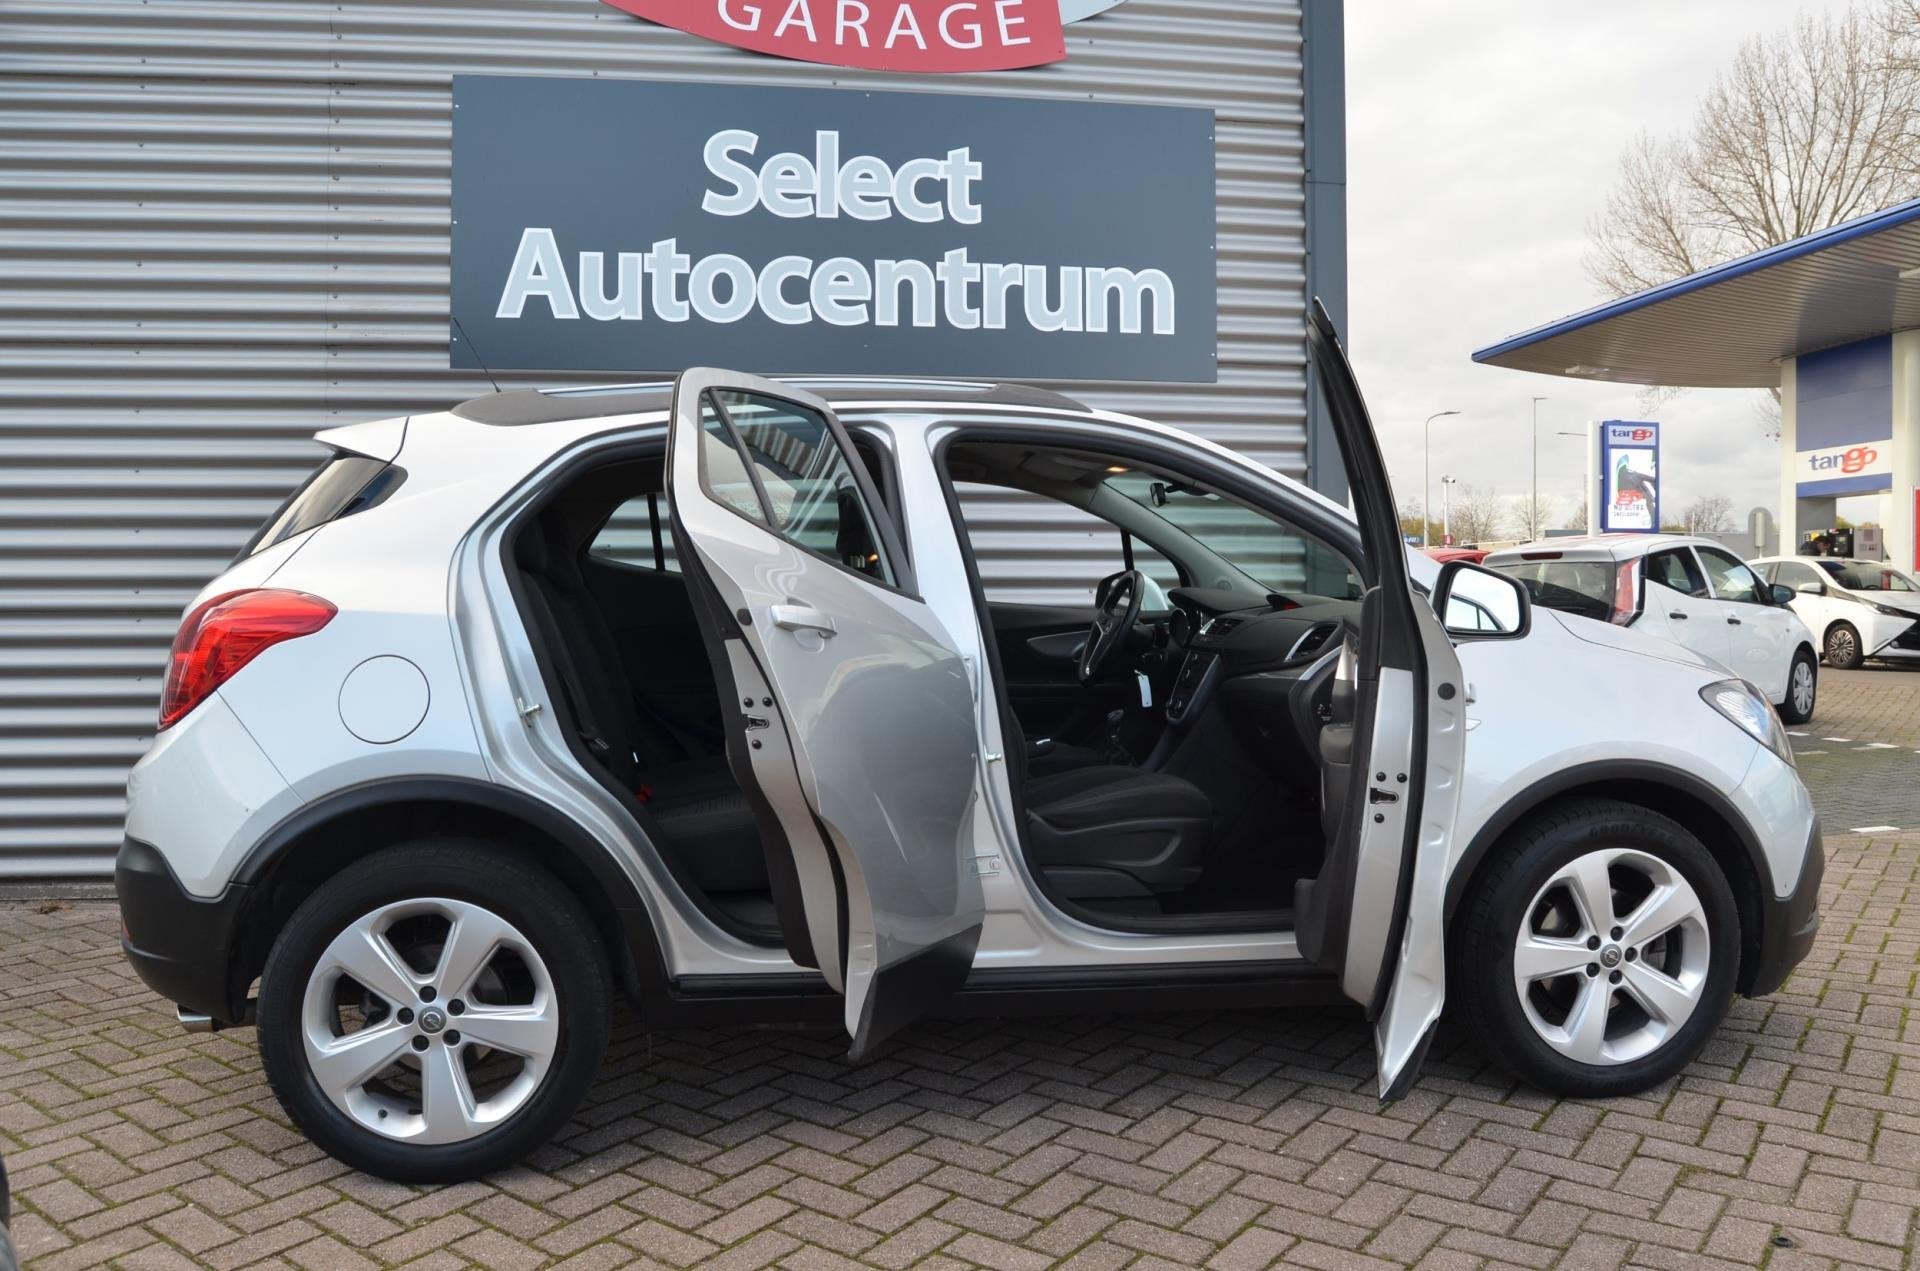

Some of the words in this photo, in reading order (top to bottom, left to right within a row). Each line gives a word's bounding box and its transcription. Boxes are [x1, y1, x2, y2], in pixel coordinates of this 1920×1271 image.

[717, 0, 1031, 50] GARAGE
[701, 129, 983, 225] Select
[495, 227, 1176, 336] Autocentrum
[1611, 428, 1654, 441] tango
[1808, 446, 1878, 474] tango
